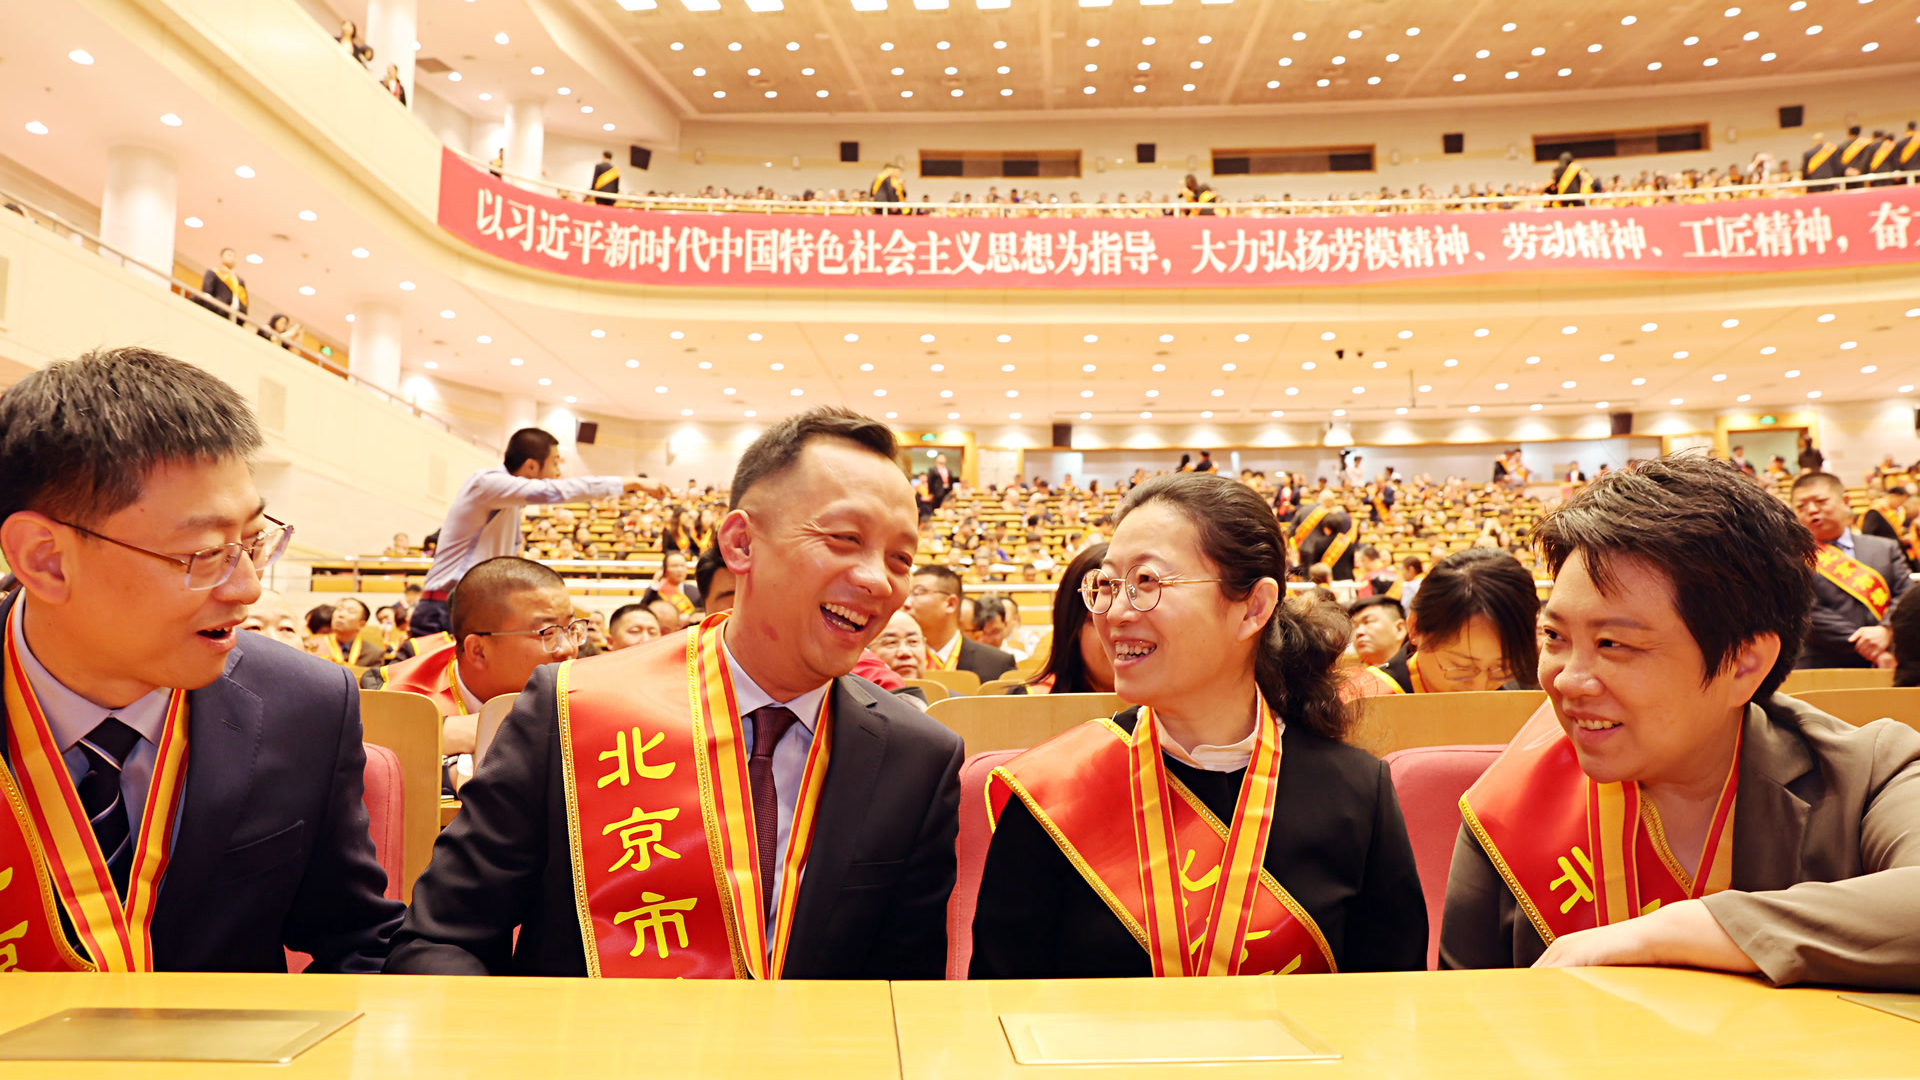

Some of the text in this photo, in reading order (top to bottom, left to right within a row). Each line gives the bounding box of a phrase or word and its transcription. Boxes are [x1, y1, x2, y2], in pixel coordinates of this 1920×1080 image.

[476, 187, 1920, 275] 以习近平新时代中国特色社会主义思想为指导，大力弘扬劳模精神、劳动精神、工匠精神，奋
[596, 726, 698, 959] 北京市
